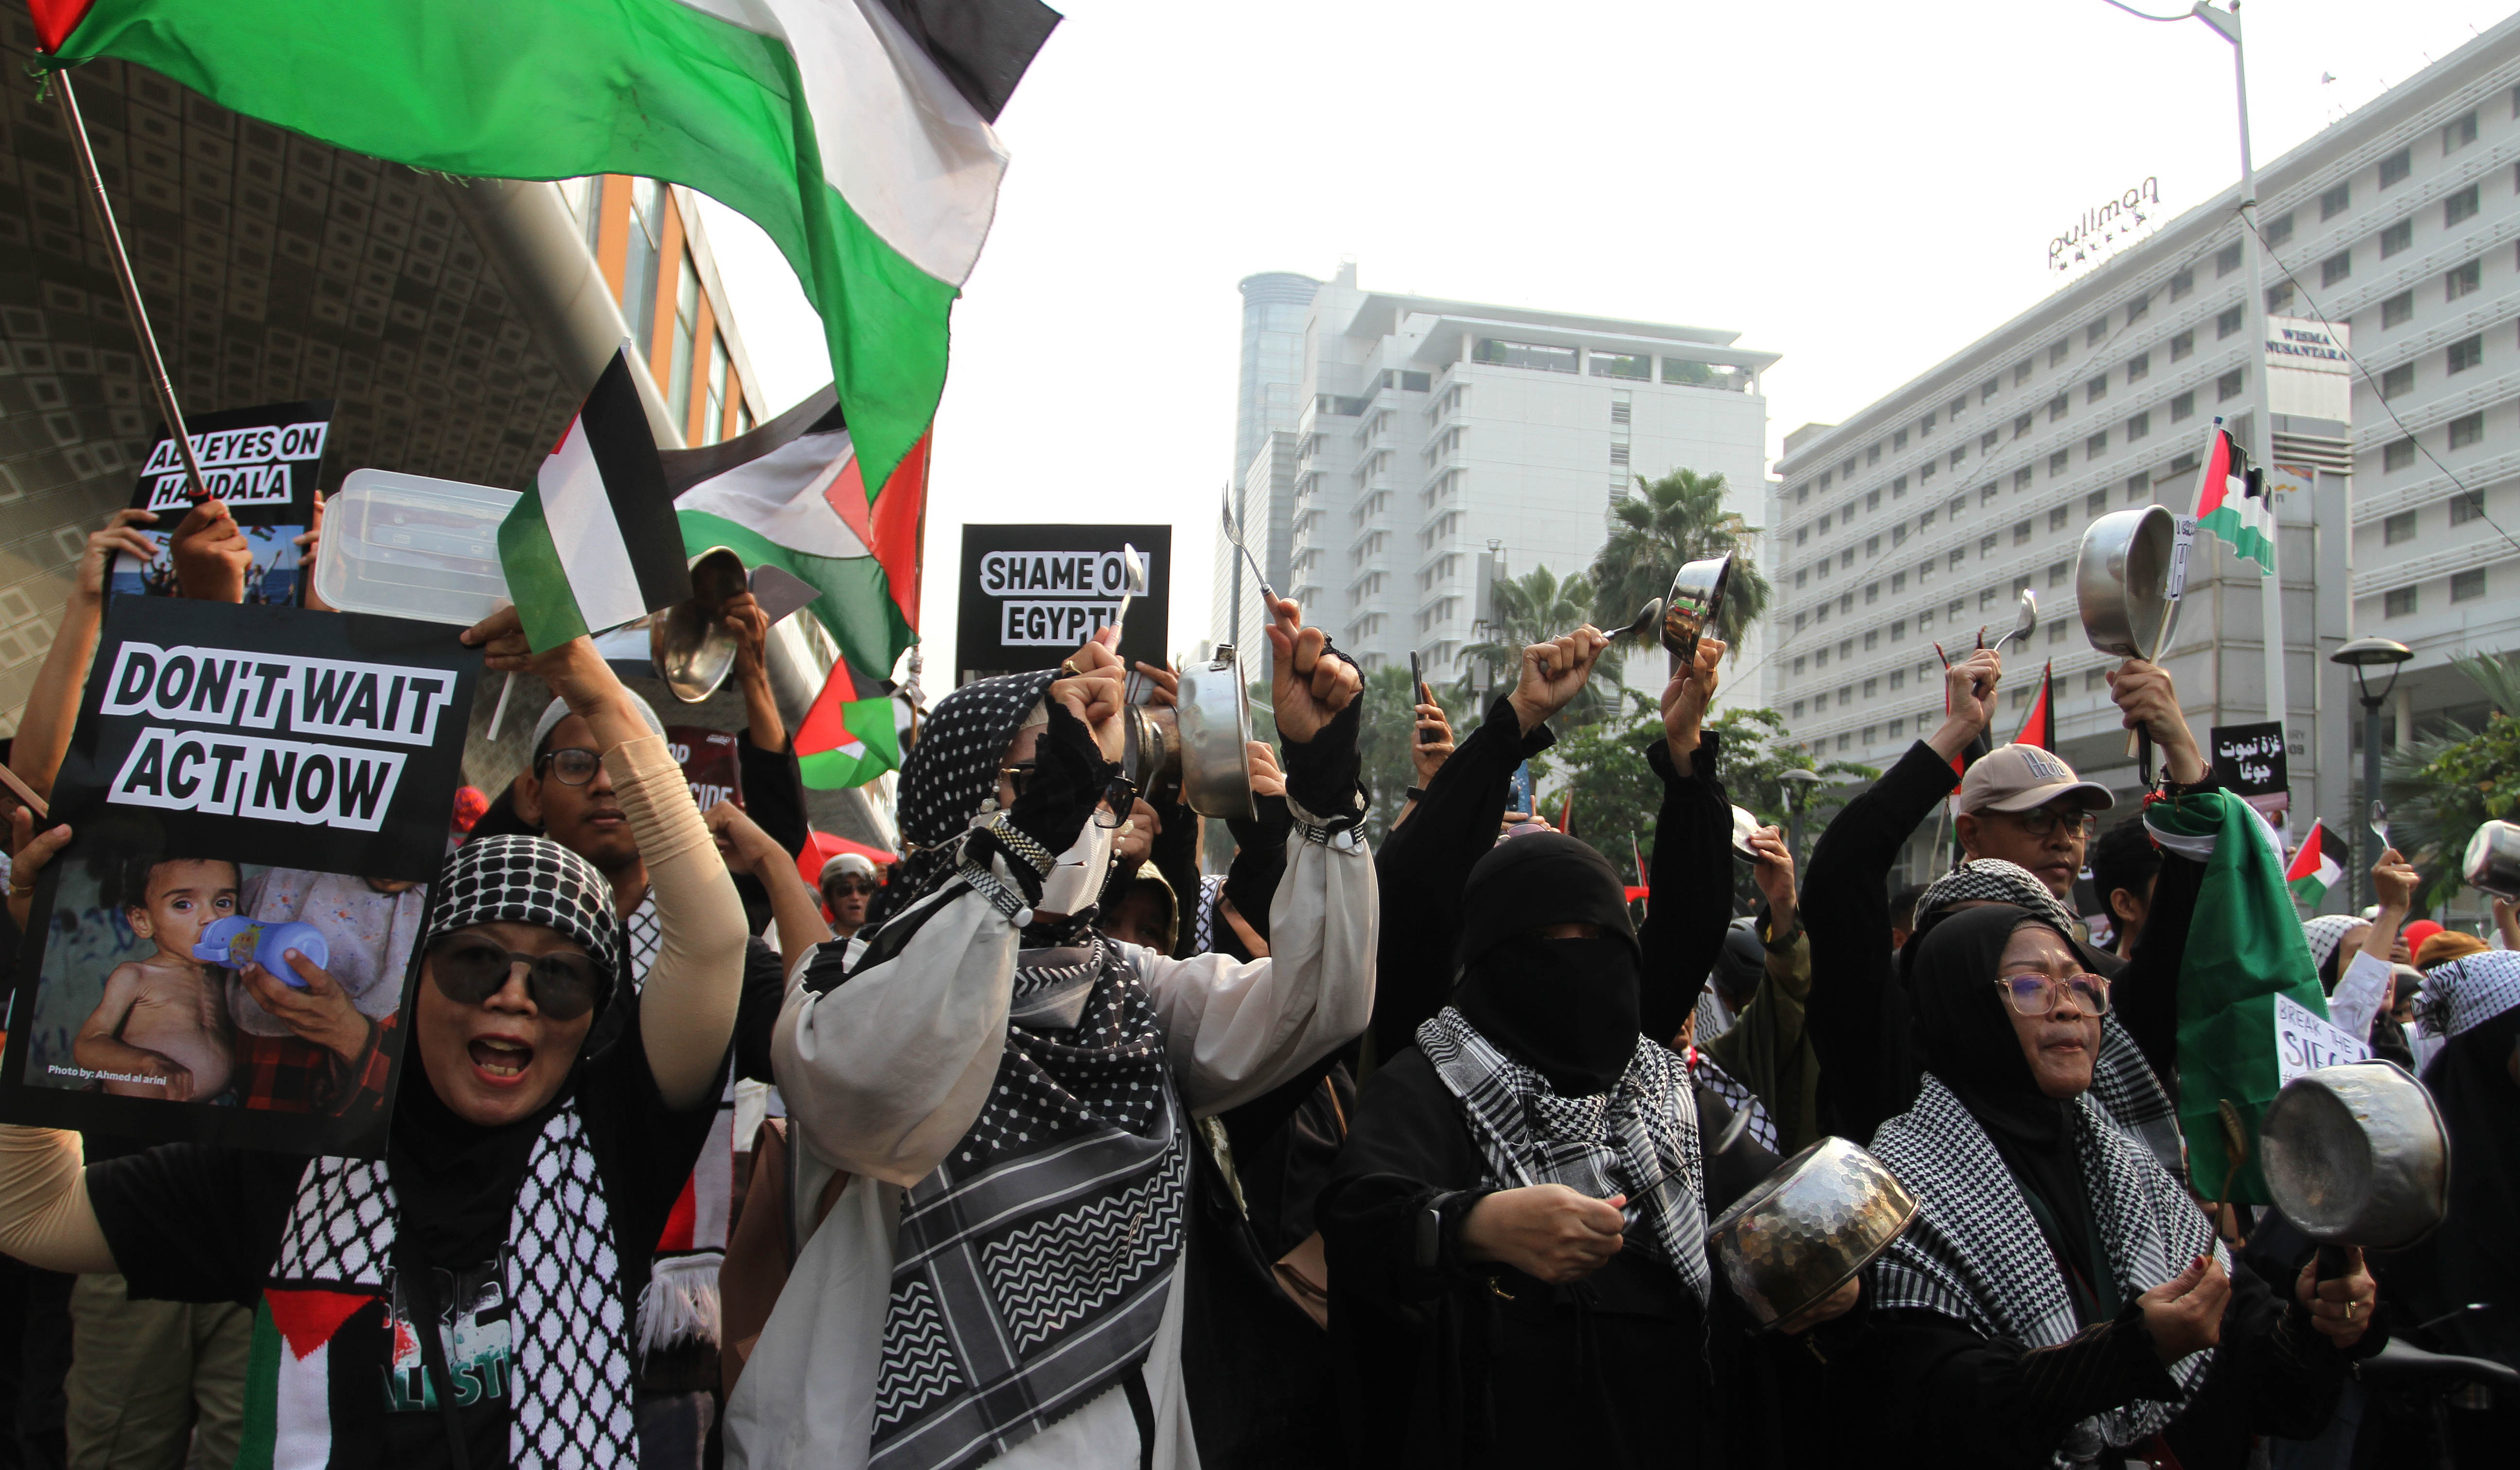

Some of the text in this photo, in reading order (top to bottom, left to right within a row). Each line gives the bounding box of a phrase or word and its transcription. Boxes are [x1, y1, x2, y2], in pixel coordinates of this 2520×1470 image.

[2049, 176, 2160, 269] pullman
[2265, 341, 2347, 361] NUSANTARA
[2281, 329, 2330, 344] WISMA
[149, 427, 321, 470] AL EYES ON
[986, 557, 1093, 590] SHAME
[114, 652, 443, 735] DON'T WAIT
[2261, 734, 2280, 758] غزة
[122, 738, 391, 820] ACT NOW
[2279, 1000, 2321, 1036] BREAK
[2328, 1029, 2352, 1054] THE
[48, 1065, 166, 1085] Photo by: Ahmed al arini
